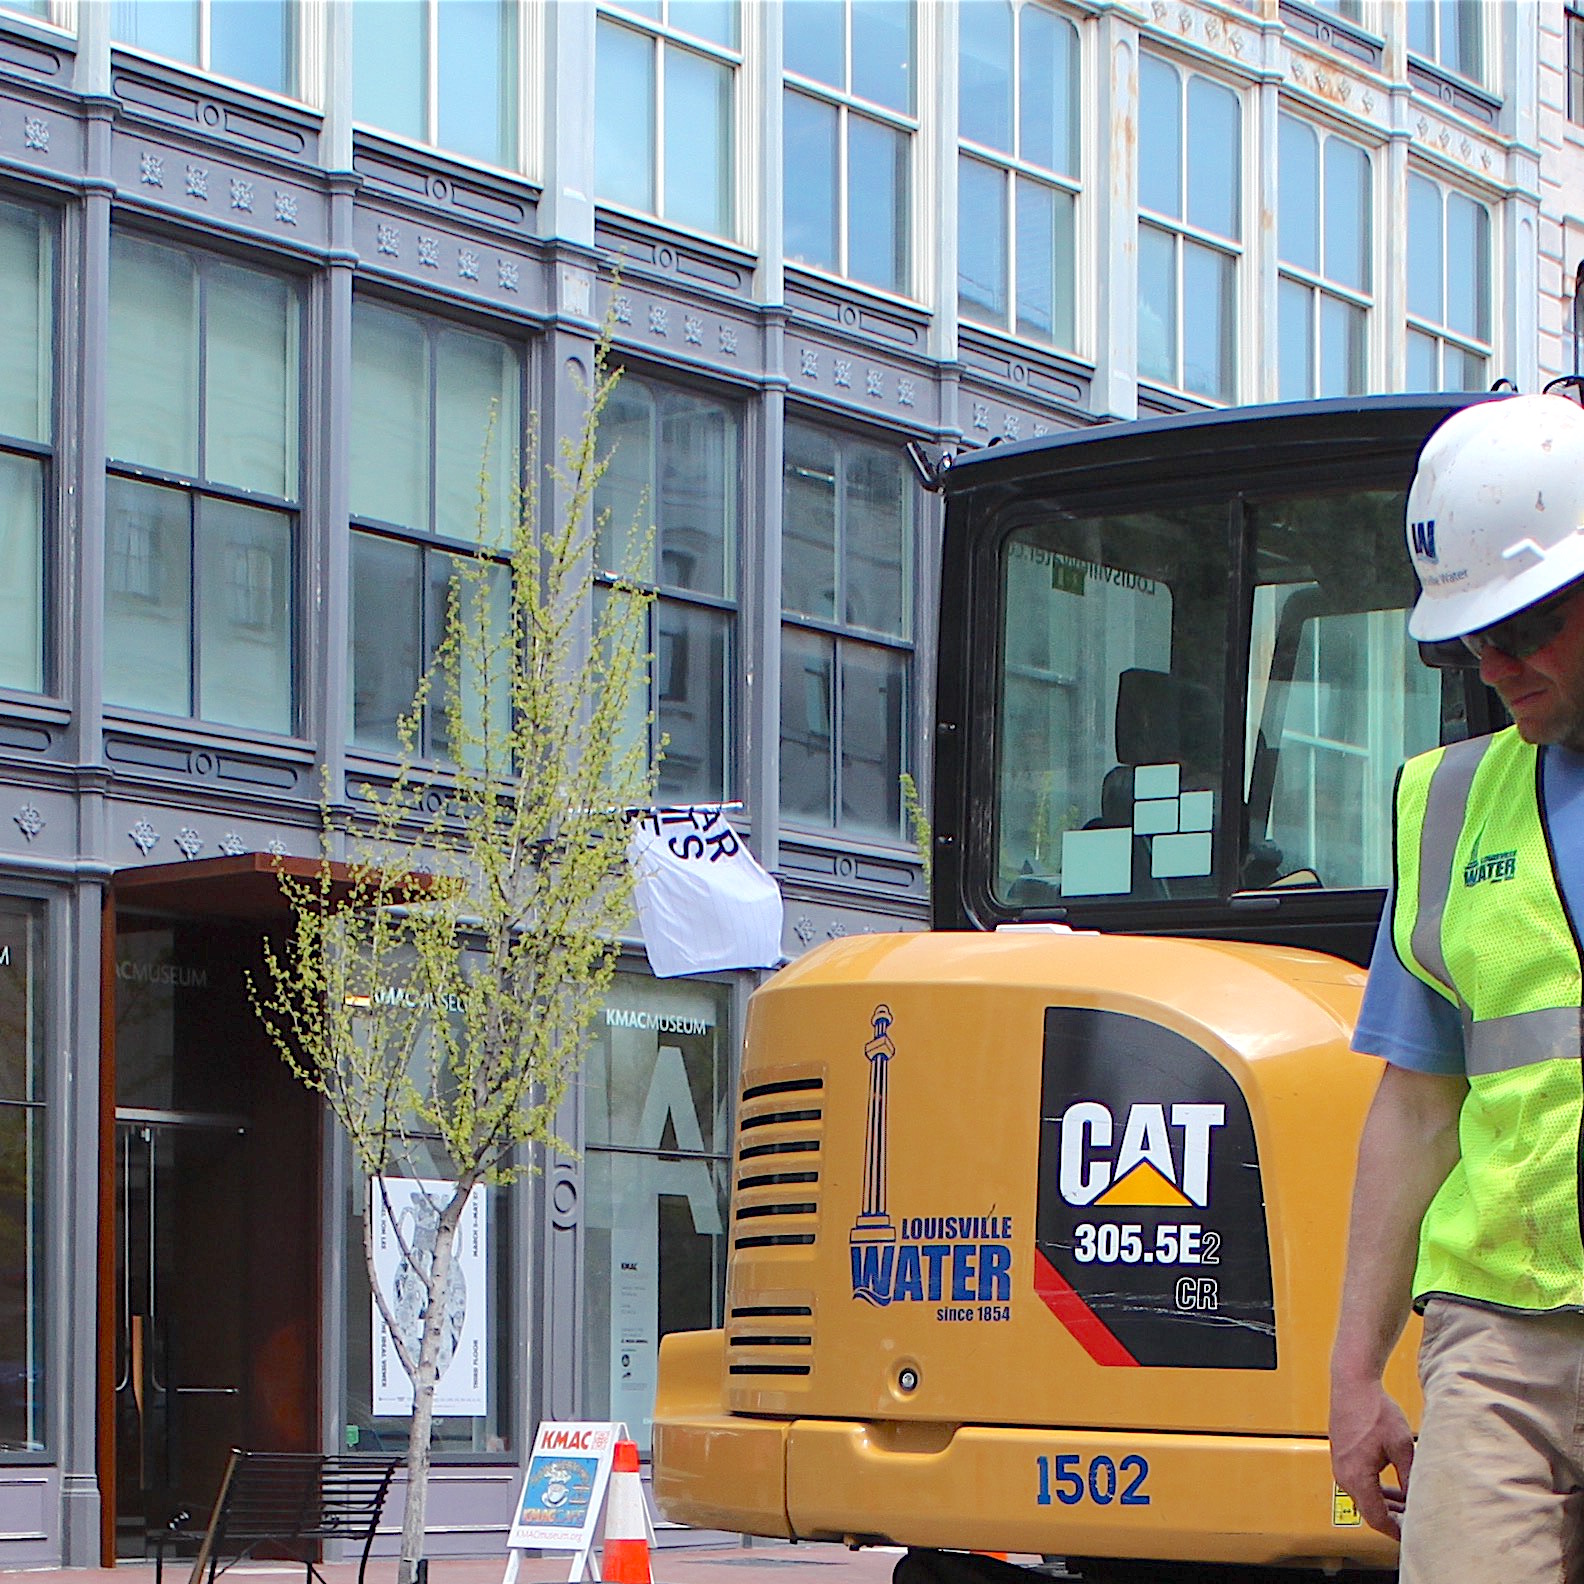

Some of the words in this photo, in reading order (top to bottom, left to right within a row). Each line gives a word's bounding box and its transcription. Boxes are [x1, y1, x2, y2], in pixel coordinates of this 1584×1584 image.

[1464, 858, 1516, 886] WATER
[606, 1009, 706, 1035] KMACMUSEUM
[1059, 1101, 1225, 1207] CAT
[902, 1217, 1012, 1239] LOUISVILLE
[1074, 1224, 1221, 1264] 305.5E2
[850, 1245, 1011, 1305] WATER
[1175, 1277, 1218, 1310] CR
[937, 1306, 973, 1321] since
[977, 1306, 1010, 1321] 1854
[541, 1430, 593, 1450] KMAC
[1037, 1455, 1150, 1505] 1502
